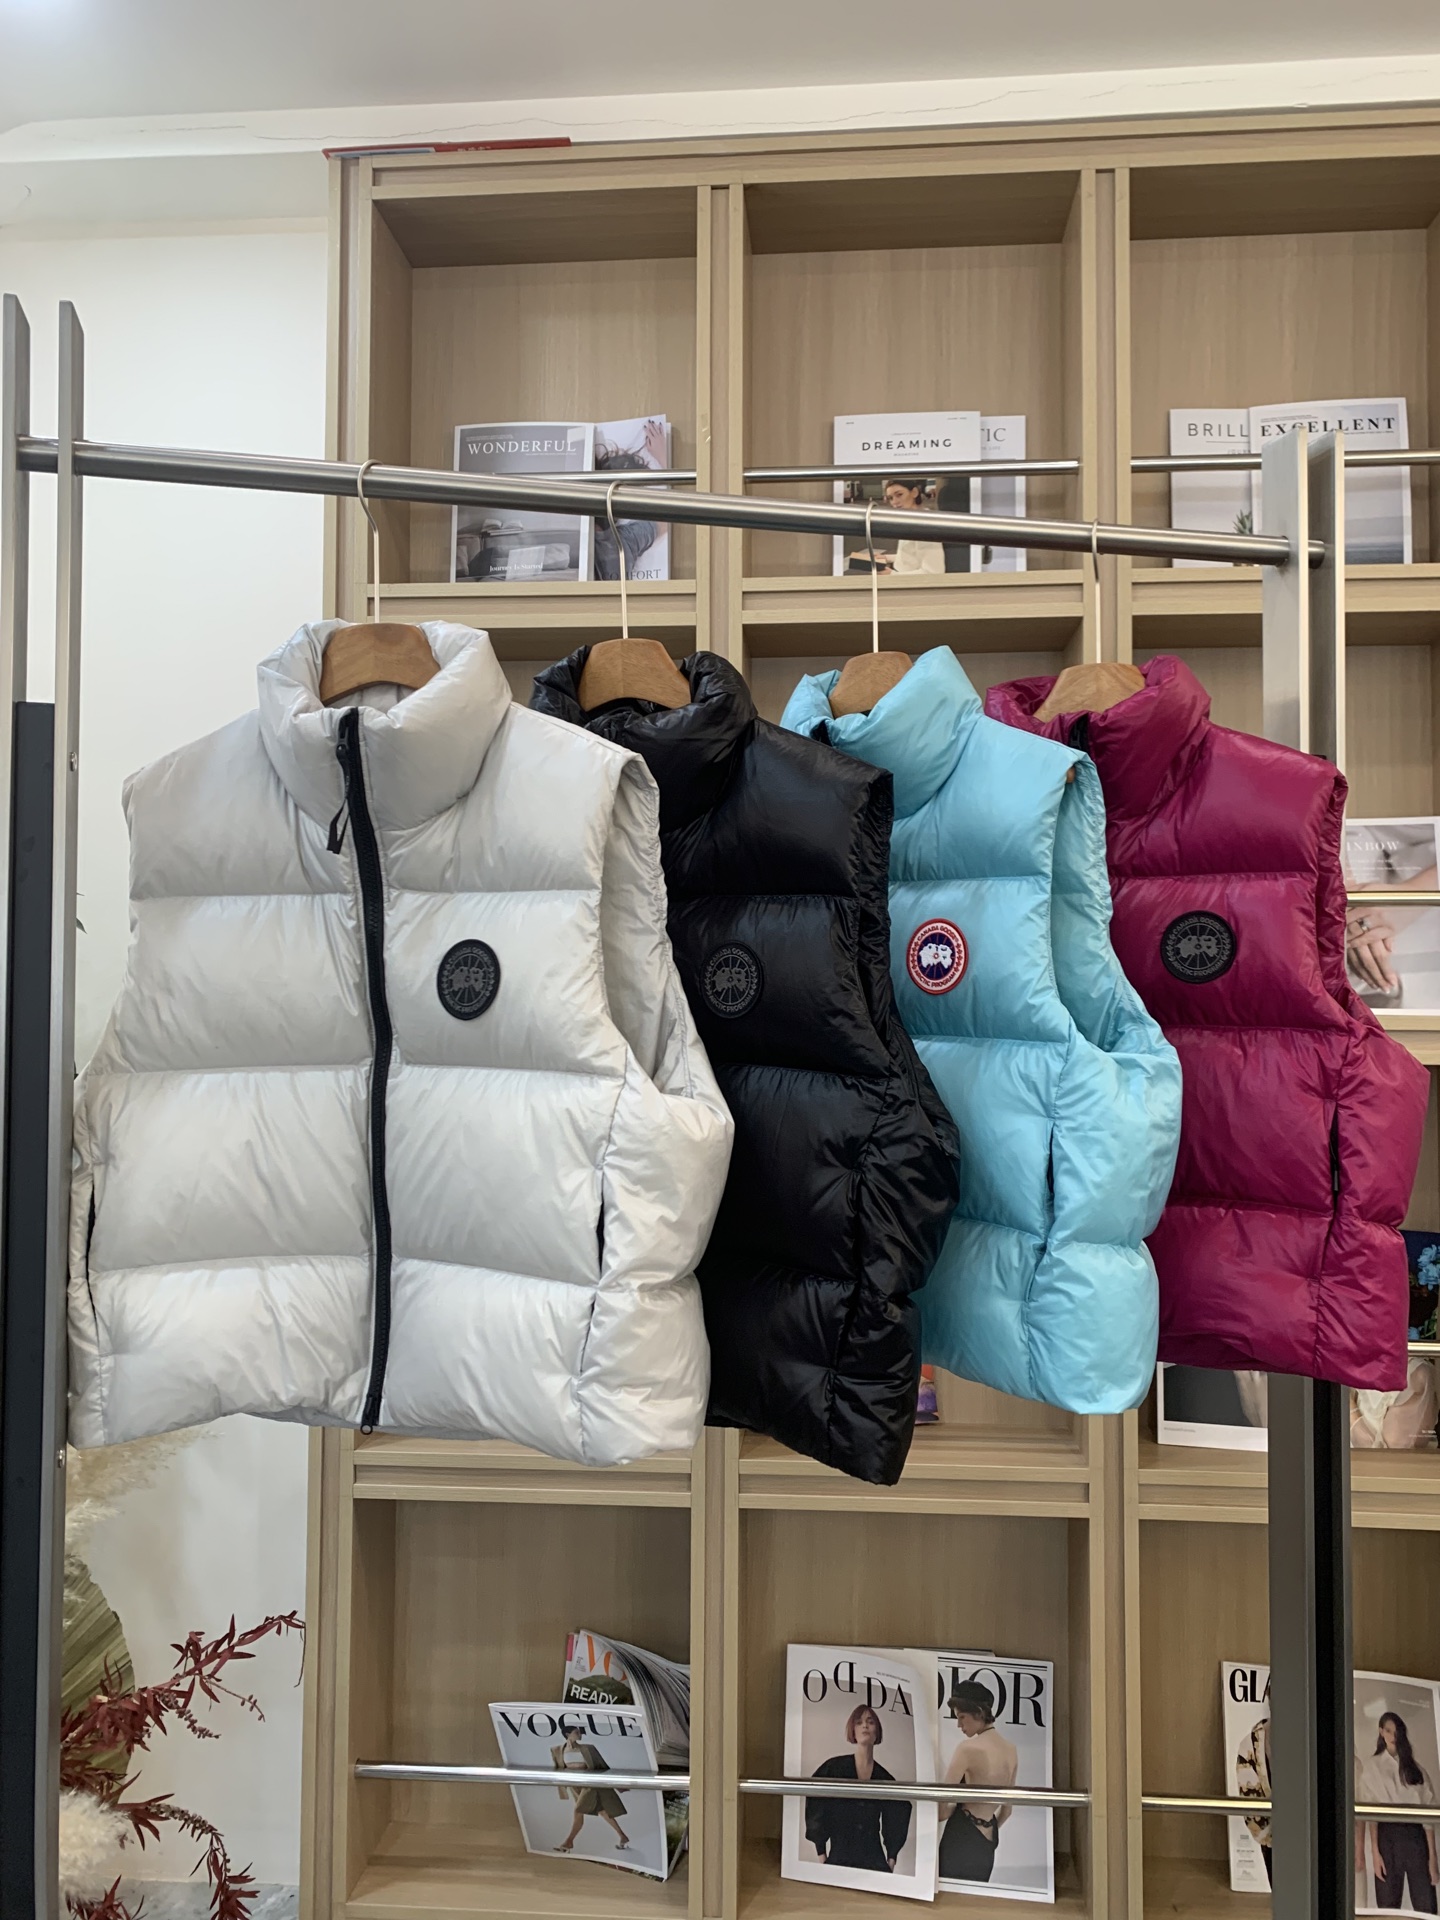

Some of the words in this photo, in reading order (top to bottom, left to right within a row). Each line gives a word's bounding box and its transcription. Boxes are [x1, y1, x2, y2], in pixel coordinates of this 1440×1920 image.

[1187, 422, 1249, 438] BRILL
[467, 439, 577, 455] WONDERFUL
[861, 438, 952, 452] DREAMING
[602, 568, 661, 580] COFORT
[570, 1683, 618, 1704] READY
[937, 1665, 1047, 1728] IOR
[498, 1711, 643, 1738] VOGUE
